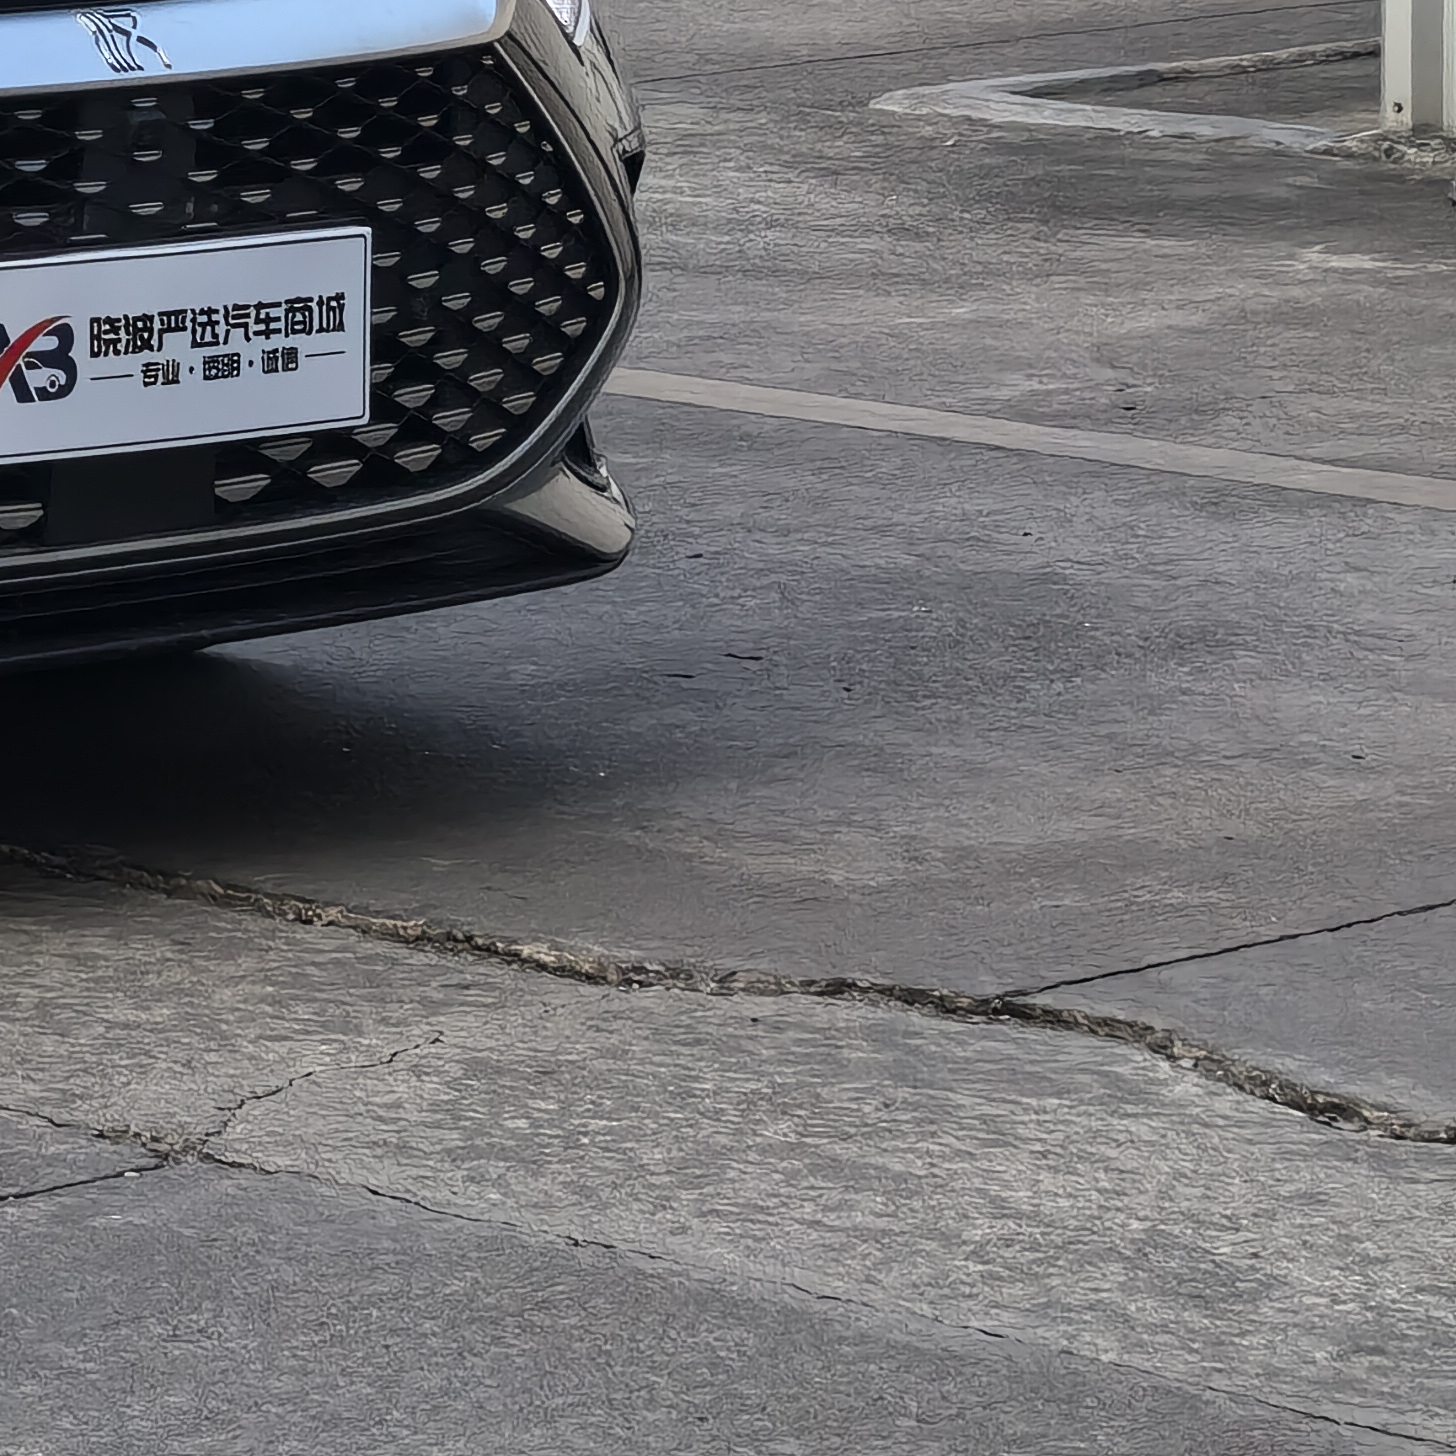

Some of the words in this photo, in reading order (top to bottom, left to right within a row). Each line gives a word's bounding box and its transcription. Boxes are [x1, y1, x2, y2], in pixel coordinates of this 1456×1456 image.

[89, 291, 346, 359] 晓波严选汽车商城
